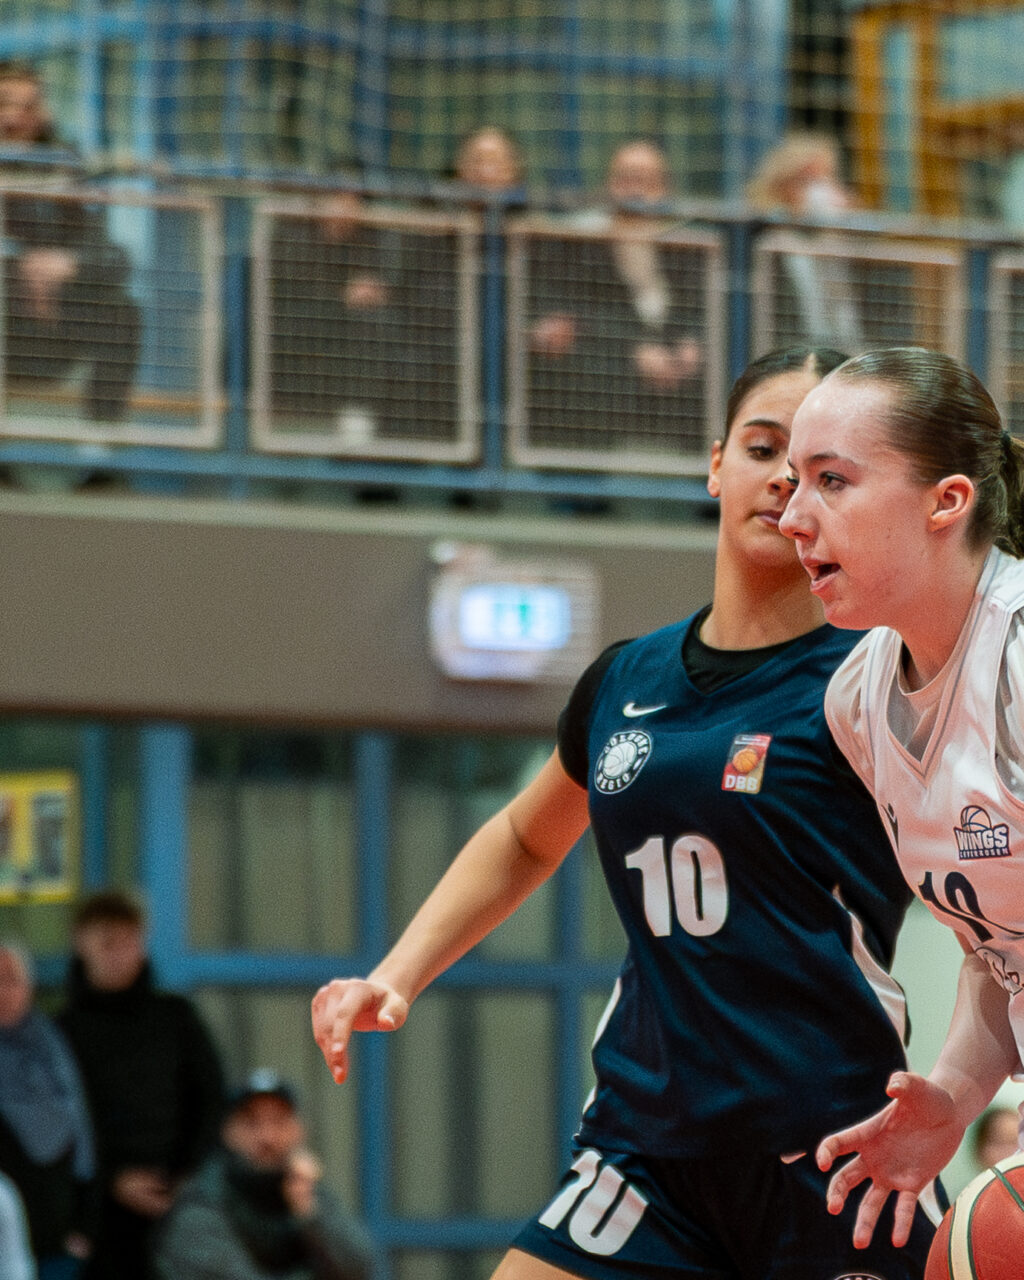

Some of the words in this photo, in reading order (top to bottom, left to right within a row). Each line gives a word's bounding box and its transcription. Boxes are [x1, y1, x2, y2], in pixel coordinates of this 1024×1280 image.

[725, 774, 758, 792] DBB
[955, 826, 1007, 850] WINGS
[625, 834, 729, 937] 10
[538, 1150, 648, 1256] 10
